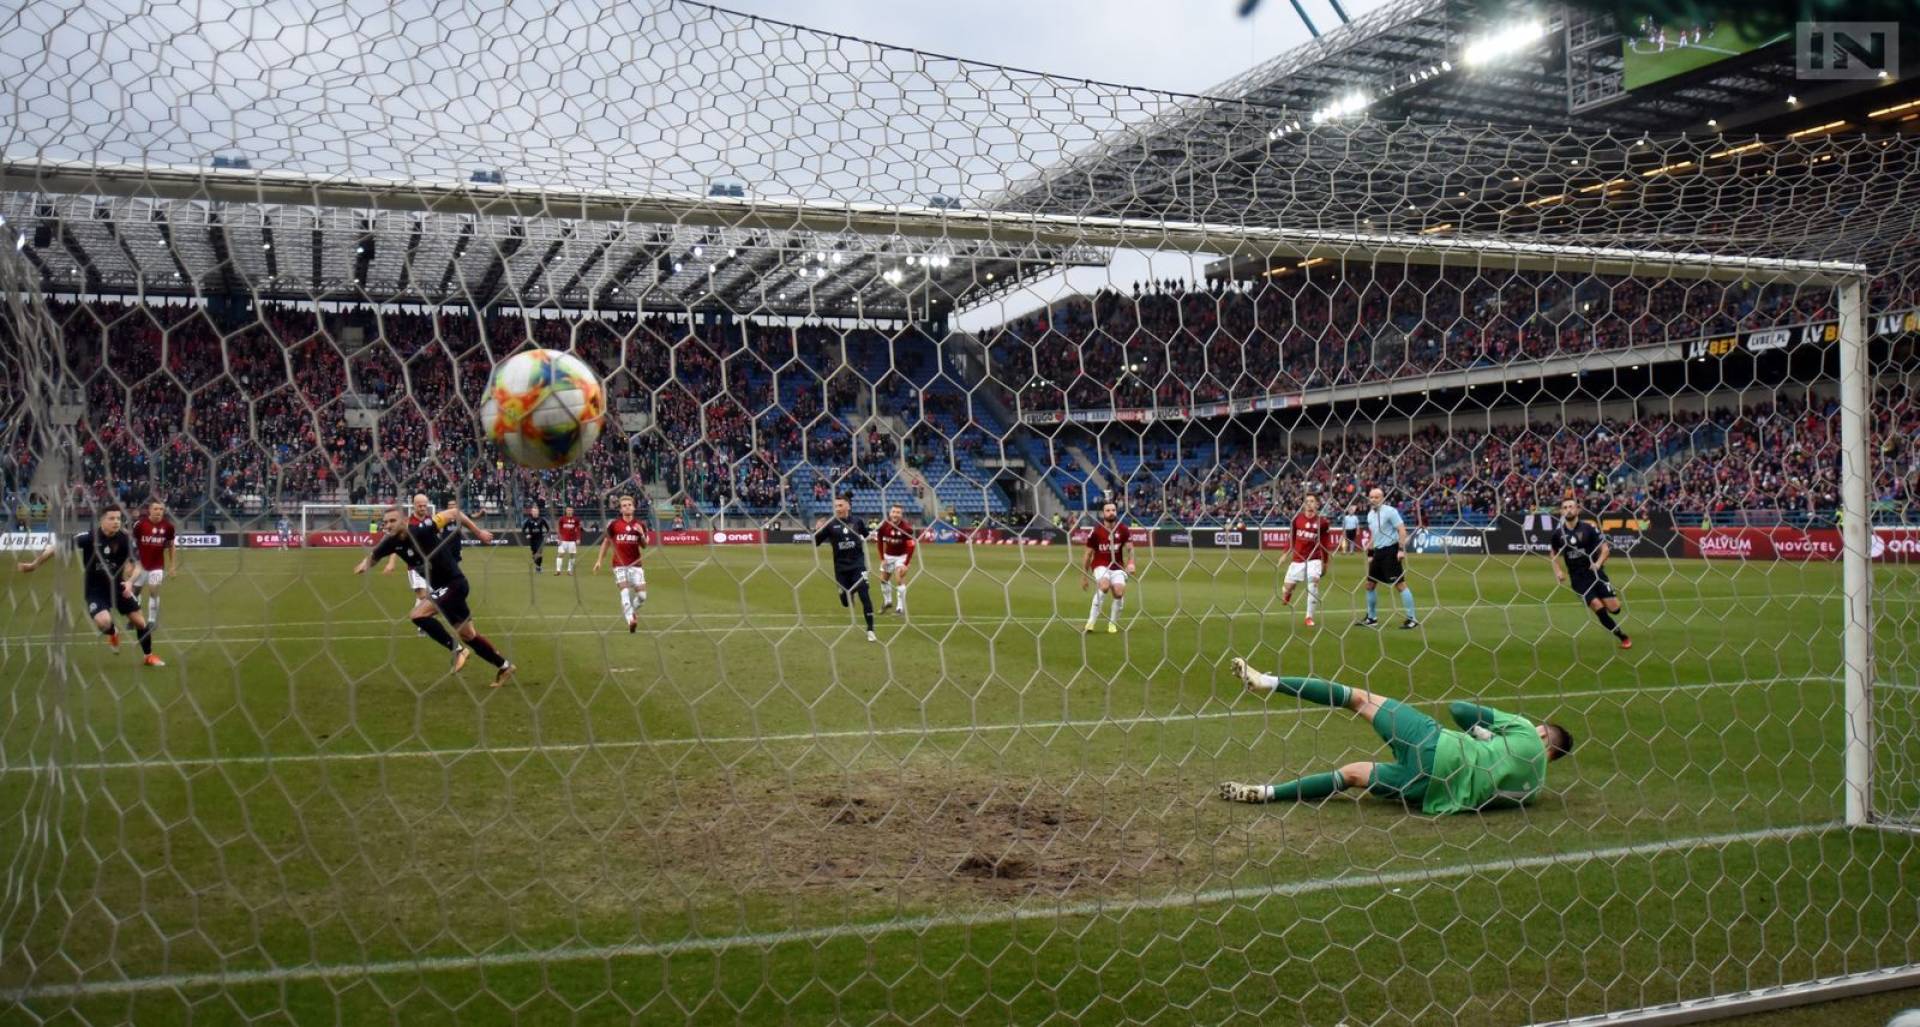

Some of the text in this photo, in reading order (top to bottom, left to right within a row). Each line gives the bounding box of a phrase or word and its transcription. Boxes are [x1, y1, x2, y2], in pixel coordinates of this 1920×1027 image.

[1878, 312, 1920, 334] LVB
[178, 536, 217, 544] OSHEE
[728, 533, 753, 541] onet
[1774, 541, 1835, 552] NOVOTEL
